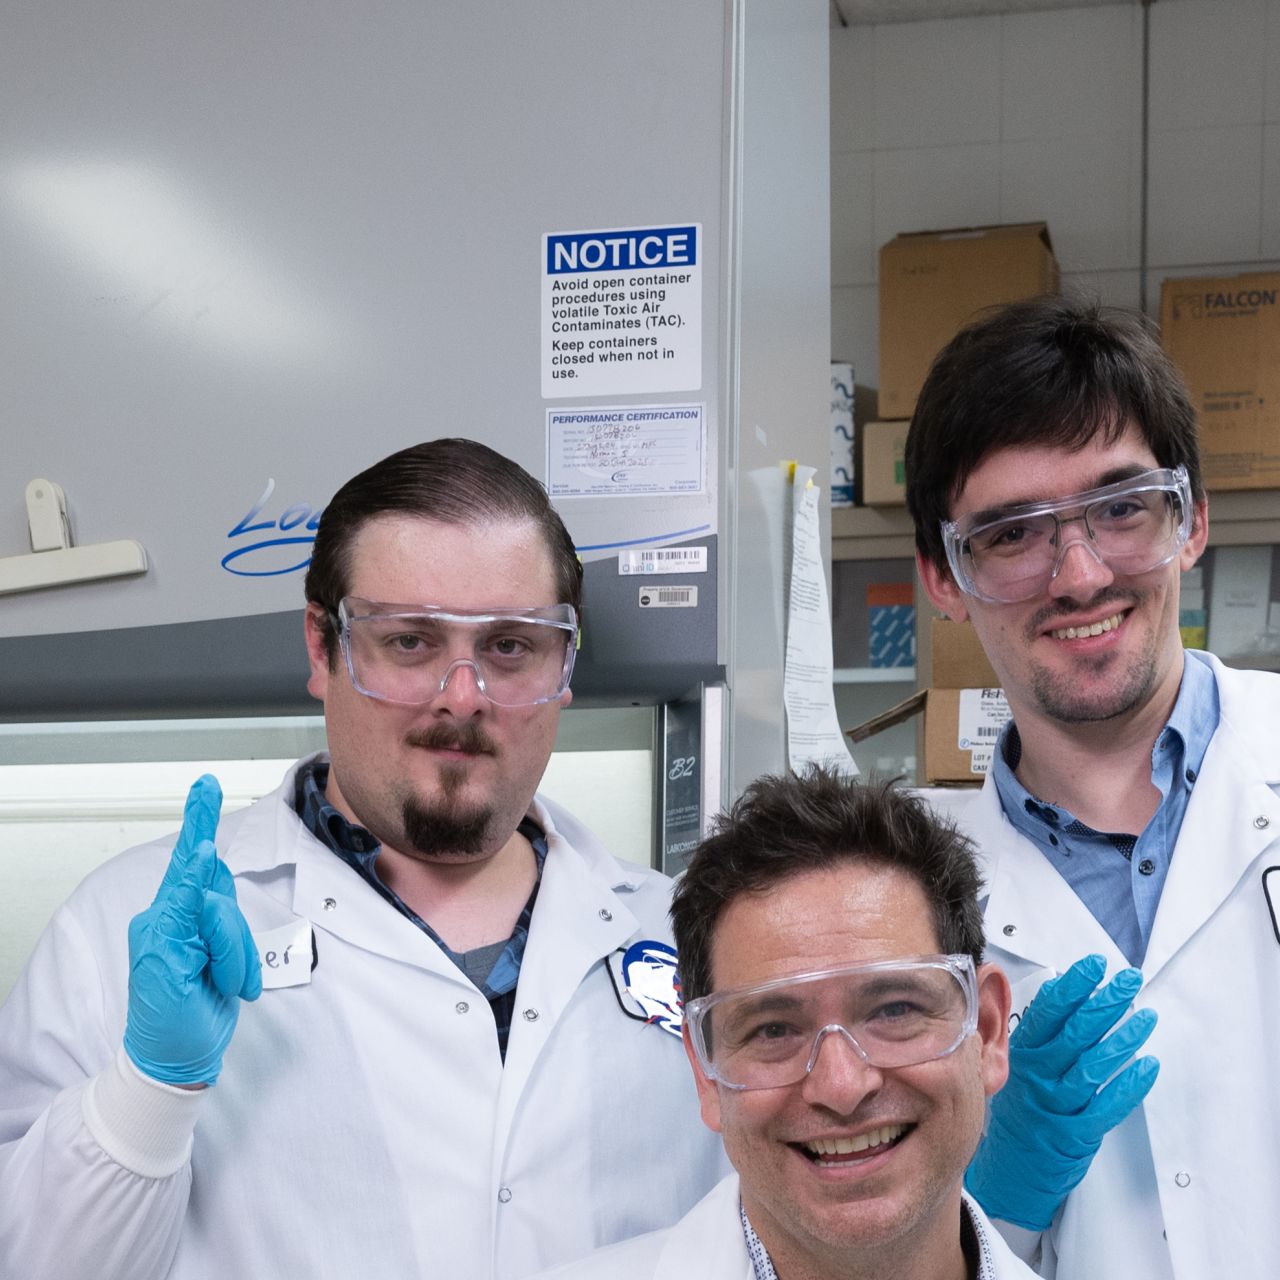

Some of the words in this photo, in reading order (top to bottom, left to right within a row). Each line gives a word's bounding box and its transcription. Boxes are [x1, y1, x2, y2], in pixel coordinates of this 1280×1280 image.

[554, 234, 689, 271] NOTICE
[552, 279, 589, 291] Avoid
[593, 278, 625, 290] open
[629, 273, 691, 287] container
[552, 291, 625, 307] procedures
[630, 289, 666, 301] using
[1204, 289, 1276, 308] FALCON
[552, 306, 599, 319] volatile
[603, 304, 638, 316] Toxic
[642, 302, 661, 313] Air
[552, 318, 641, 333] Contaminates
[645, 314, 686, 330] (TAC).
[552, 340, 584, 352] Keep
[588, 336, 658, 349] containers
[552, 352, 594, 365] closed
[598, 351, 632, 362] when
[637, 349, 658, 360] not
[662, 348, 675, 359] in
[552, 369, 579, 379] use.
[552, 413, 624, 424] PERFORMANCE
[626, 411, 699, 422] CERTIFICATION
[669, 756, 696, 780] B2
